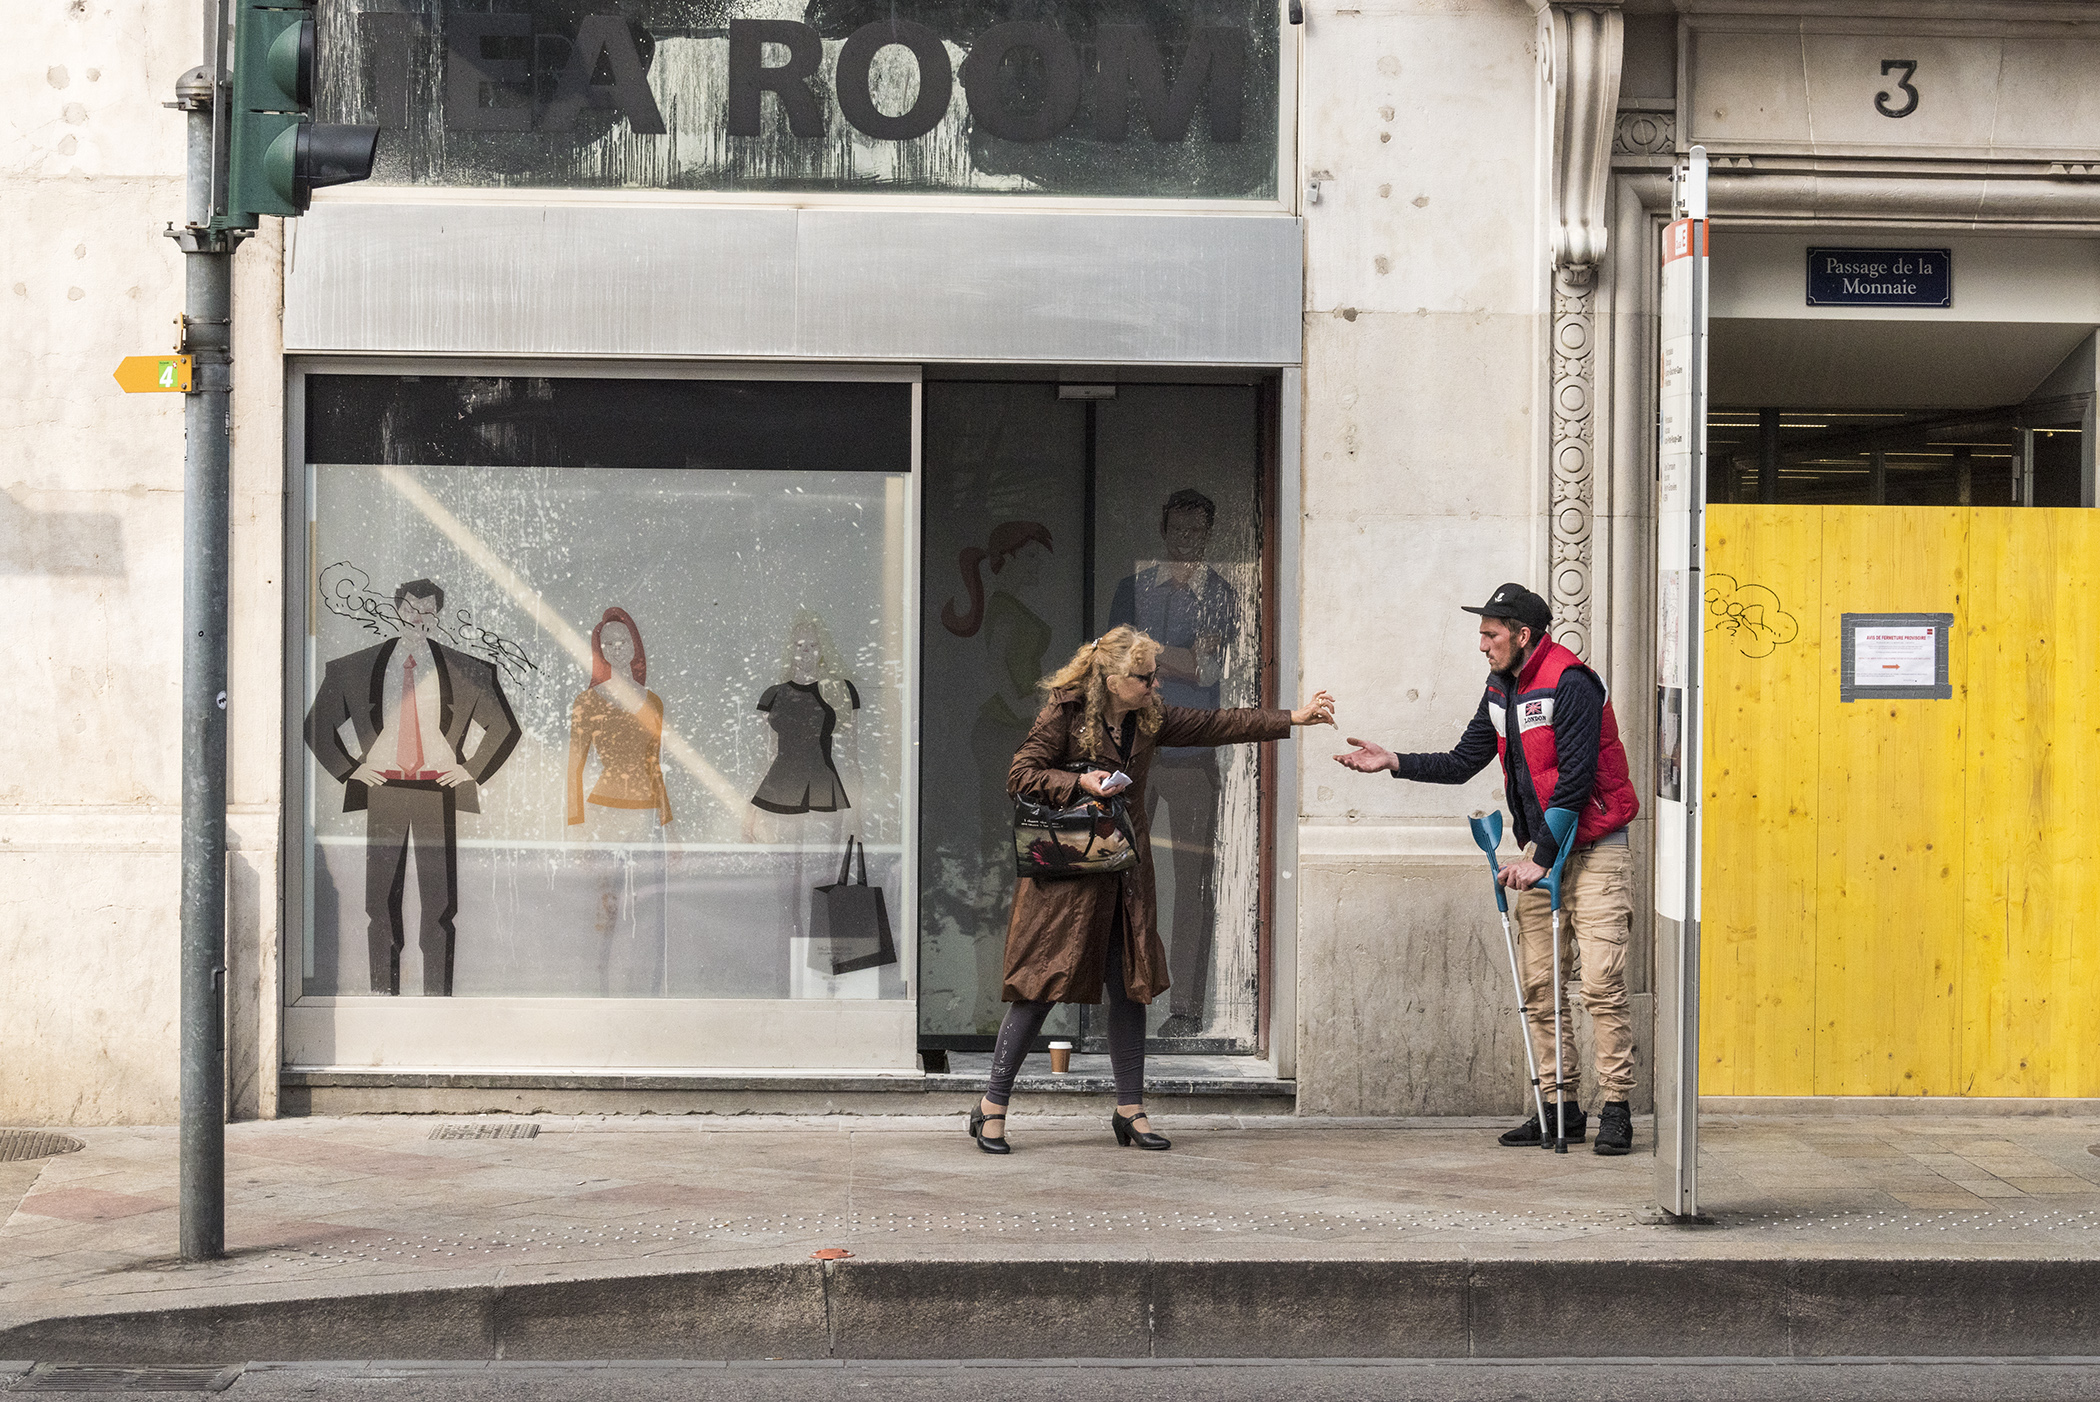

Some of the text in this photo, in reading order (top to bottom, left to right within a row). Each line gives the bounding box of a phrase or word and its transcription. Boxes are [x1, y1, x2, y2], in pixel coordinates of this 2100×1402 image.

[726, 18, 1247, 143] ROOM
[1873, 59, 1918, 118] 3
[1825, 257, 1934, 278] Passage de la
[1842, 277, 1917, 295] Monnaie
[159, 365, 174, 388] 4
[1523, 715, 1547, 724] LONDON
